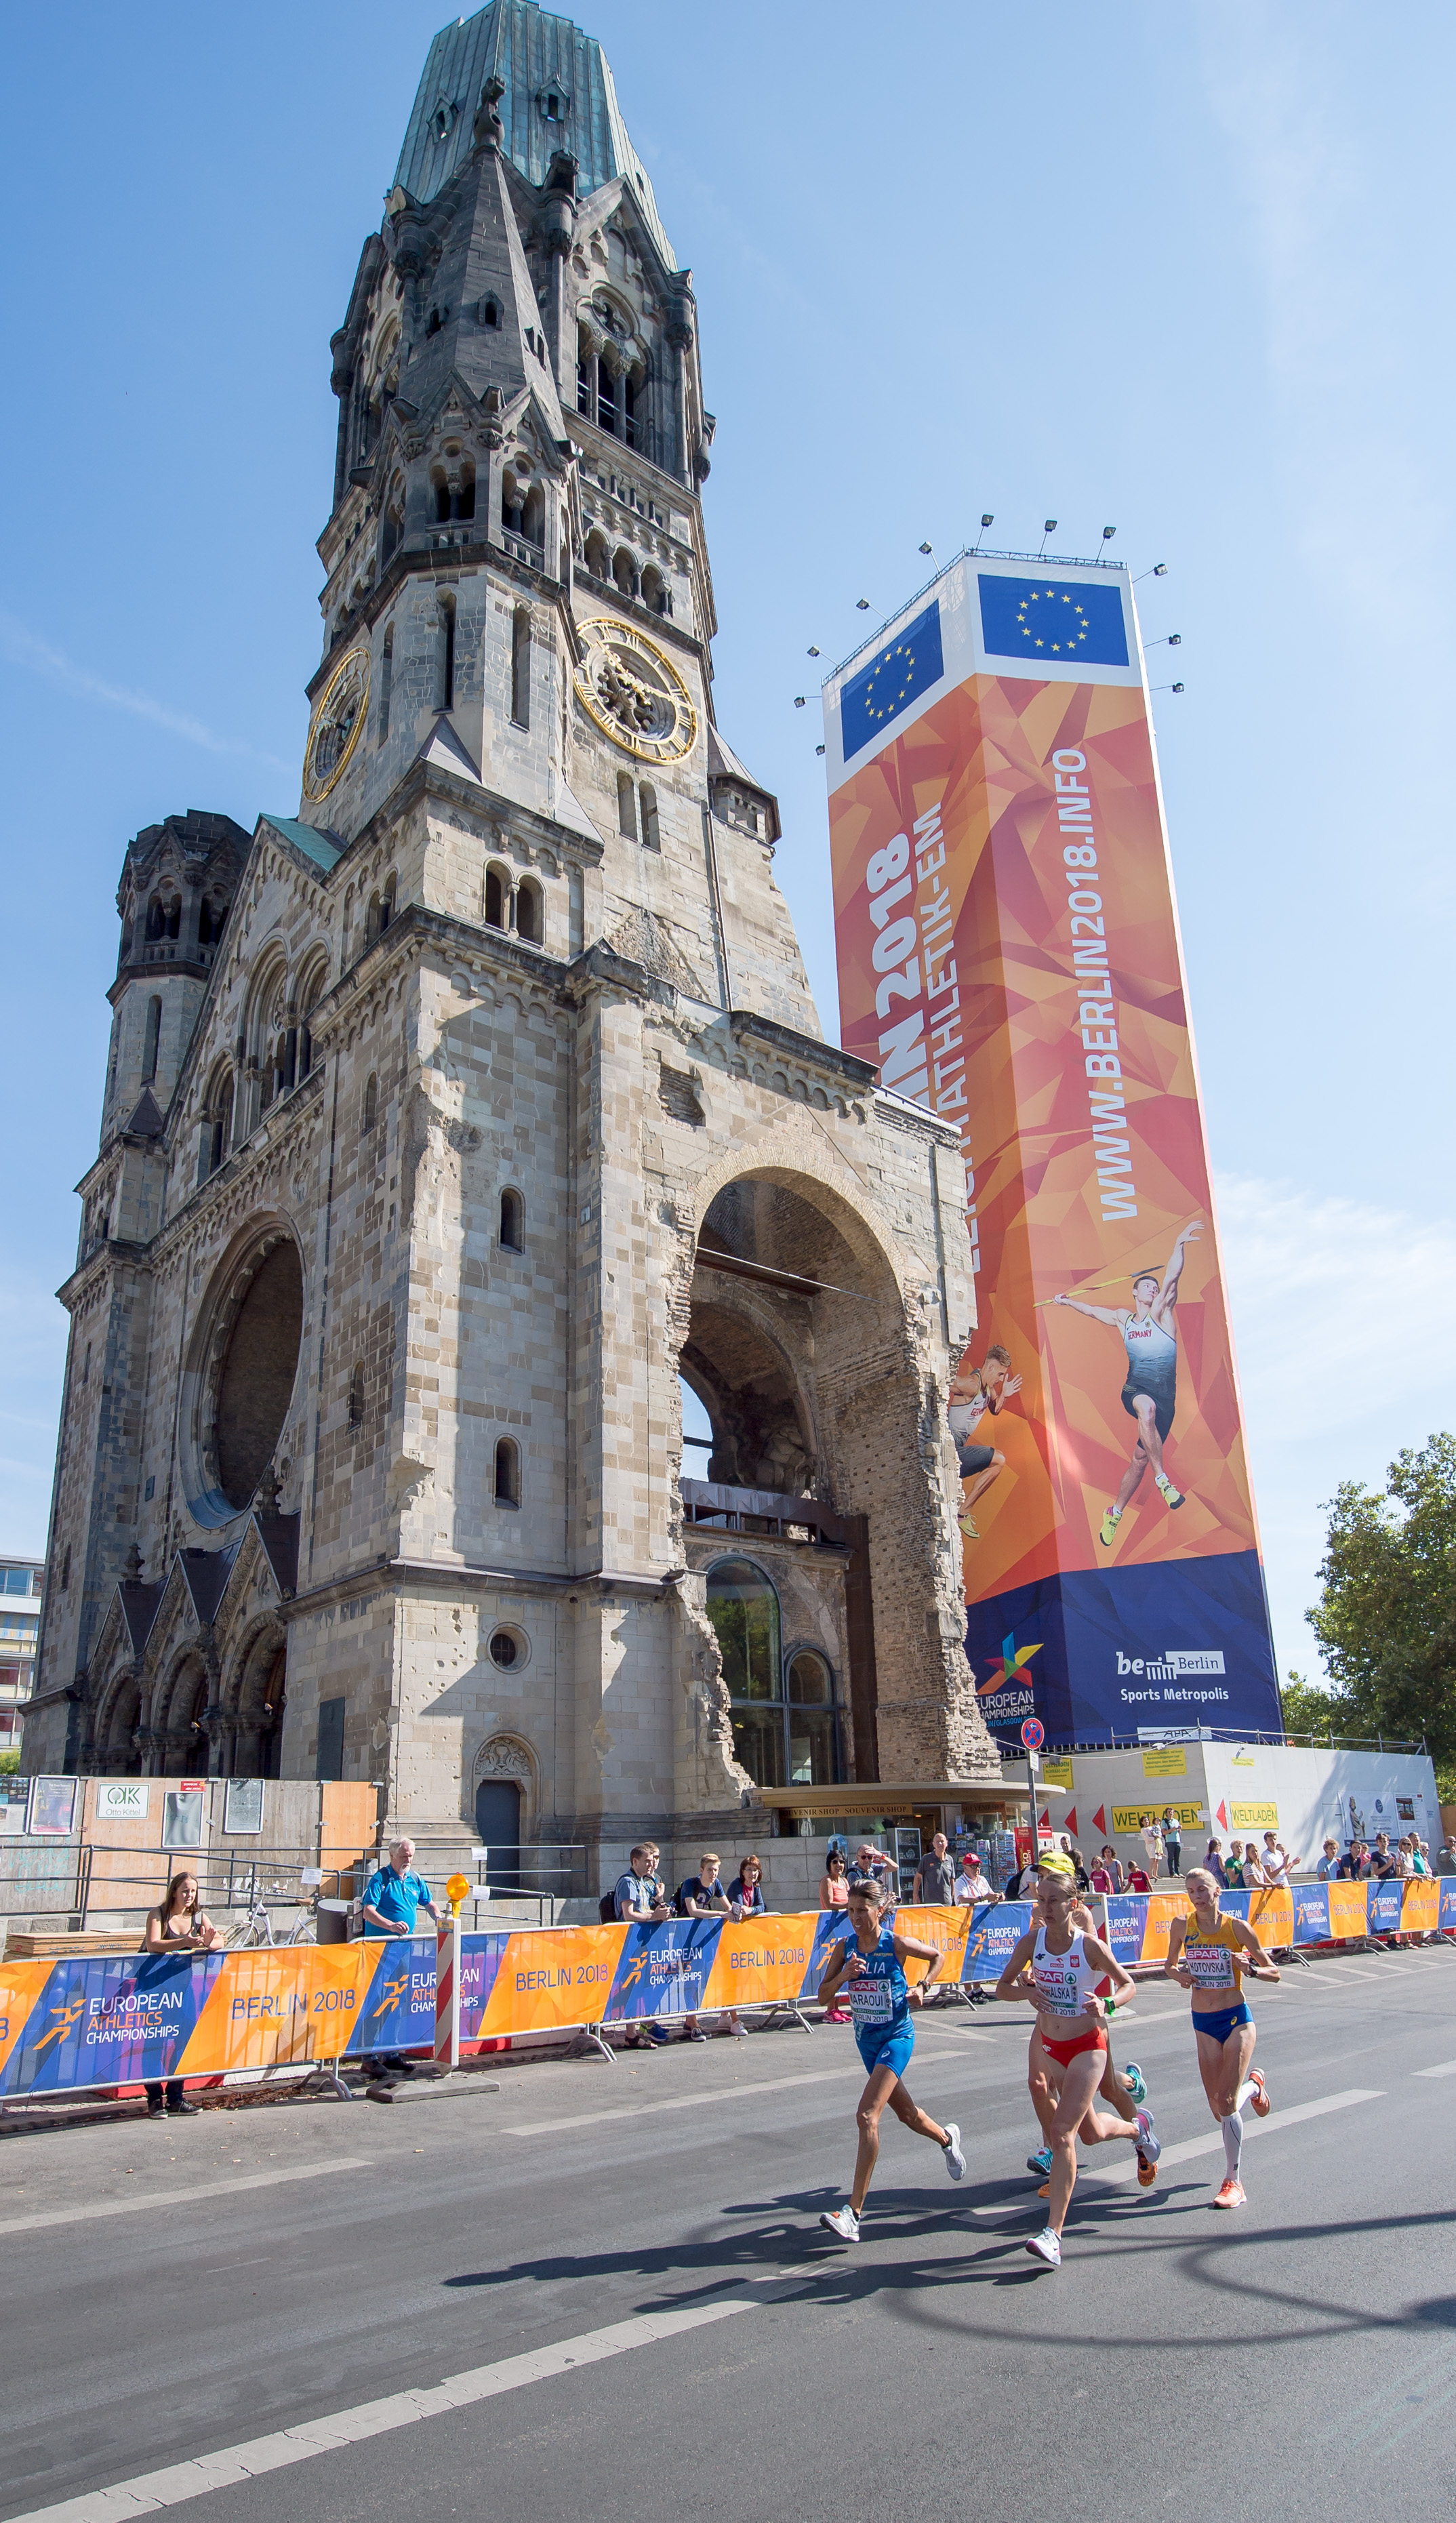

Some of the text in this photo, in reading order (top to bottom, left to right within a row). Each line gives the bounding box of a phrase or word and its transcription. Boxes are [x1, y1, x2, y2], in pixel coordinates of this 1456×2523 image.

[866, 833, 922, 1019] 2018
[1052, 748, 1138, 1222] WWW.BERLIN2018.INFO
[912, 801, 981, 1274] ATHLETIK-EM
[1116, 1651, 1219, 1675] be Berlin
[1120, 1687, 1230, 1703] Sports Metropolis
[980, 1704, 1036, 1720] HAMPIONSHIPS
[987, 1716, 1022, 1728] IN/GLASGOW
[123, 1808, 140, 1816] Kittel
[1232, 1809, 1277, 1821] WELTLADEN
[1303, 1901, 1325, 1912] EUROPEAN
[1377, 1897, 1398, 1905] EUROPEAN
[1407, 1900, 1425, 1911] BERLIN
[1333, 1904, 1352, 1916] BERLIN
[1108, 1917, 1139, 1929] EUROPEAN
[1255, 1912, 1278, 1924] BERLIN
[987, 1926, 1021, 1939] EUROPEAN
[1155, 1920, 1171, 1933] BER
[942, 1937, 963, 1952] 2018
[988, 1937, 1015, 1947] ATHLETICS
[650, 1947, 703, 1964] EUROPEAN
[988, 1946, 1015, 1956] CHAMPIONS
[1187, 1950, 1218, 1959] SPAR
[731, 1948, 805, 1969] BERLIN 2018
[649, 1961, 692, 1975] ATHLETICS
[1189, 1962, 1226, 1973] KOTOVSKA
[516, 1964, 609, 1992] BERLIN 2018
[649, 1971, 702, 1985] CHAMPIONSHIPS
[1034, 1969, 1063, 1982] SPAR
[89, 1992, 184, 2015] EUROPEAN
[232, 1989, 355, 2020] BERLIN 2018
[87, 2011, 163, 2031] ATHLETICS
[86, 2025, 180, 2044] CHAMPIONSHIPS
